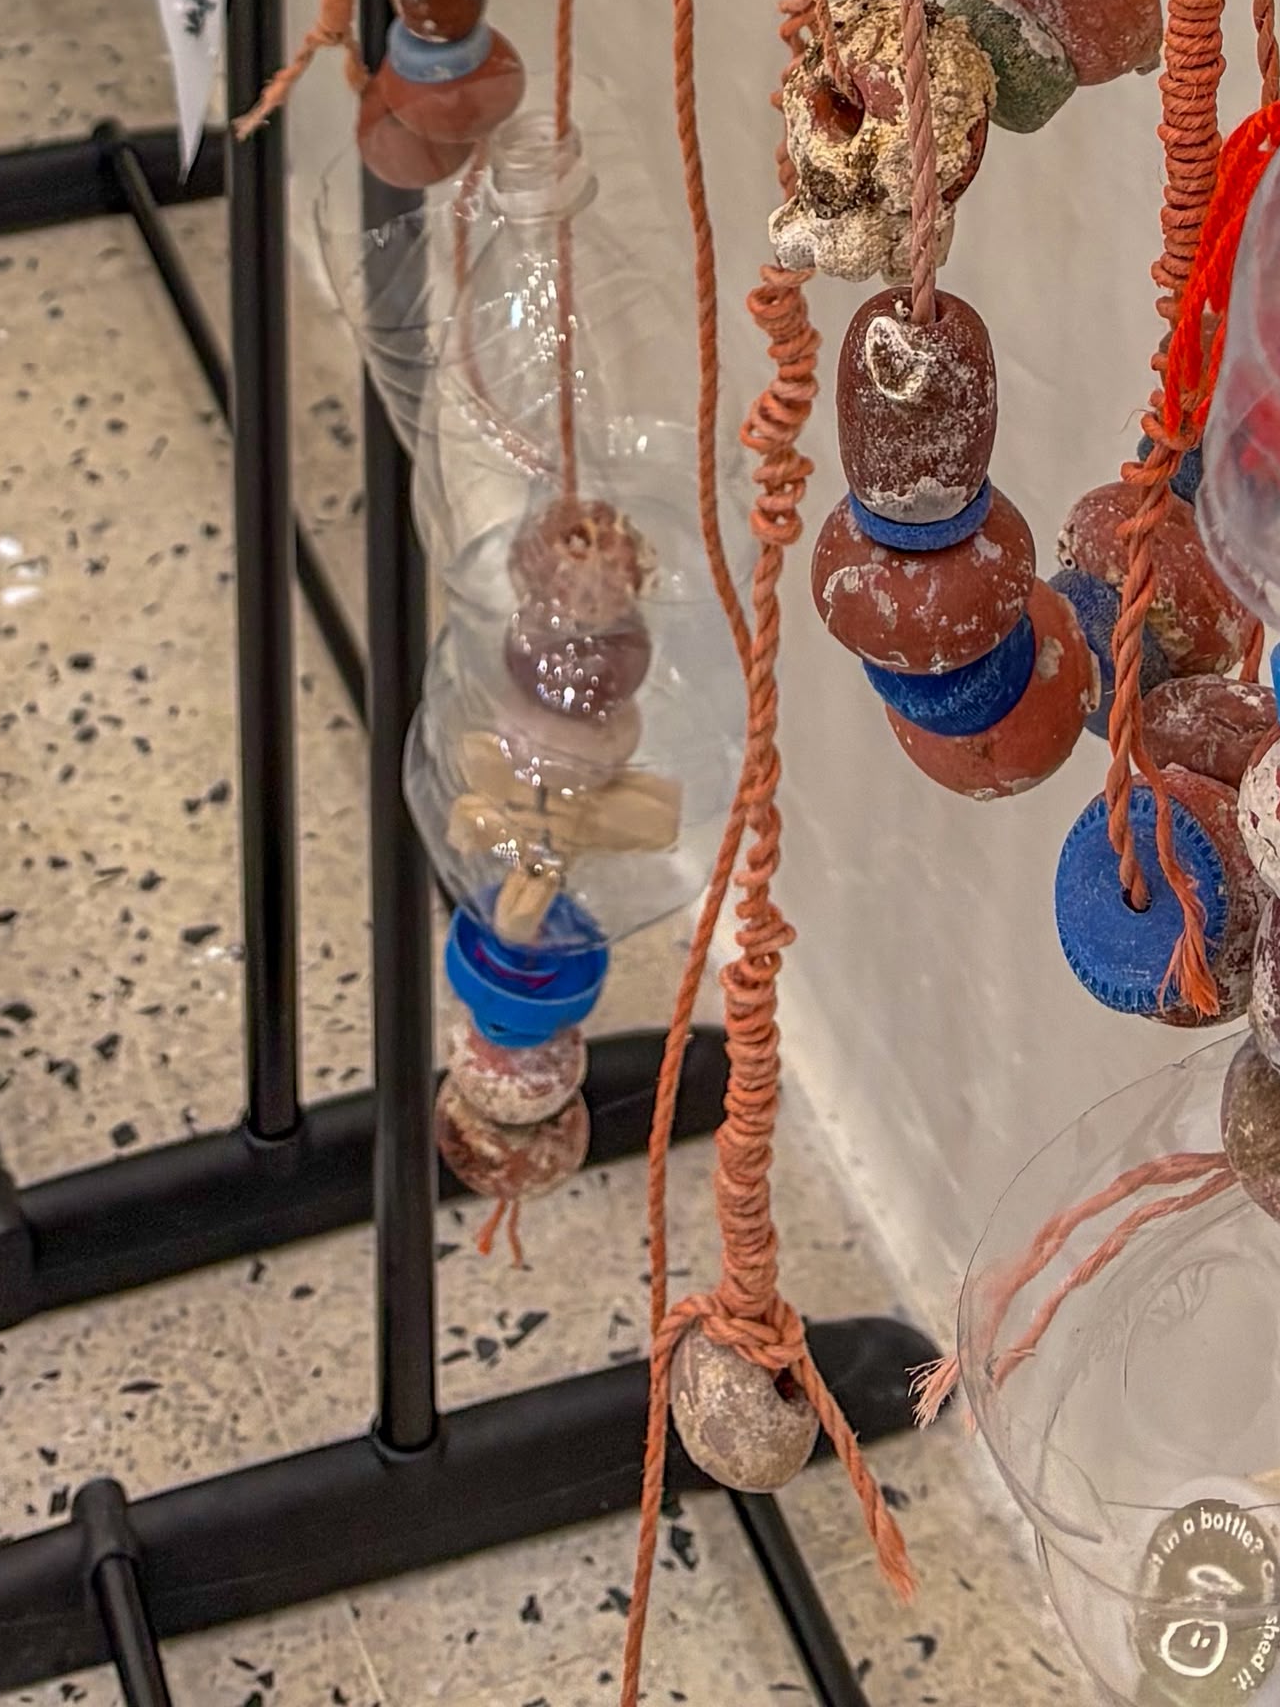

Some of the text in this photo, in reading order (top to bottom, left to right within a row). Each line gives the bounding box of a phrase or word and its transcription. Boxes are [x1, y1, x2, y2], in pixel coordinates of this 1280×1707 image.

[1162, 1530, 1180, 1554] in
[1183, 1517, 1196, 1536] a
[1200, 1506, 1265, 1554] bottle?
